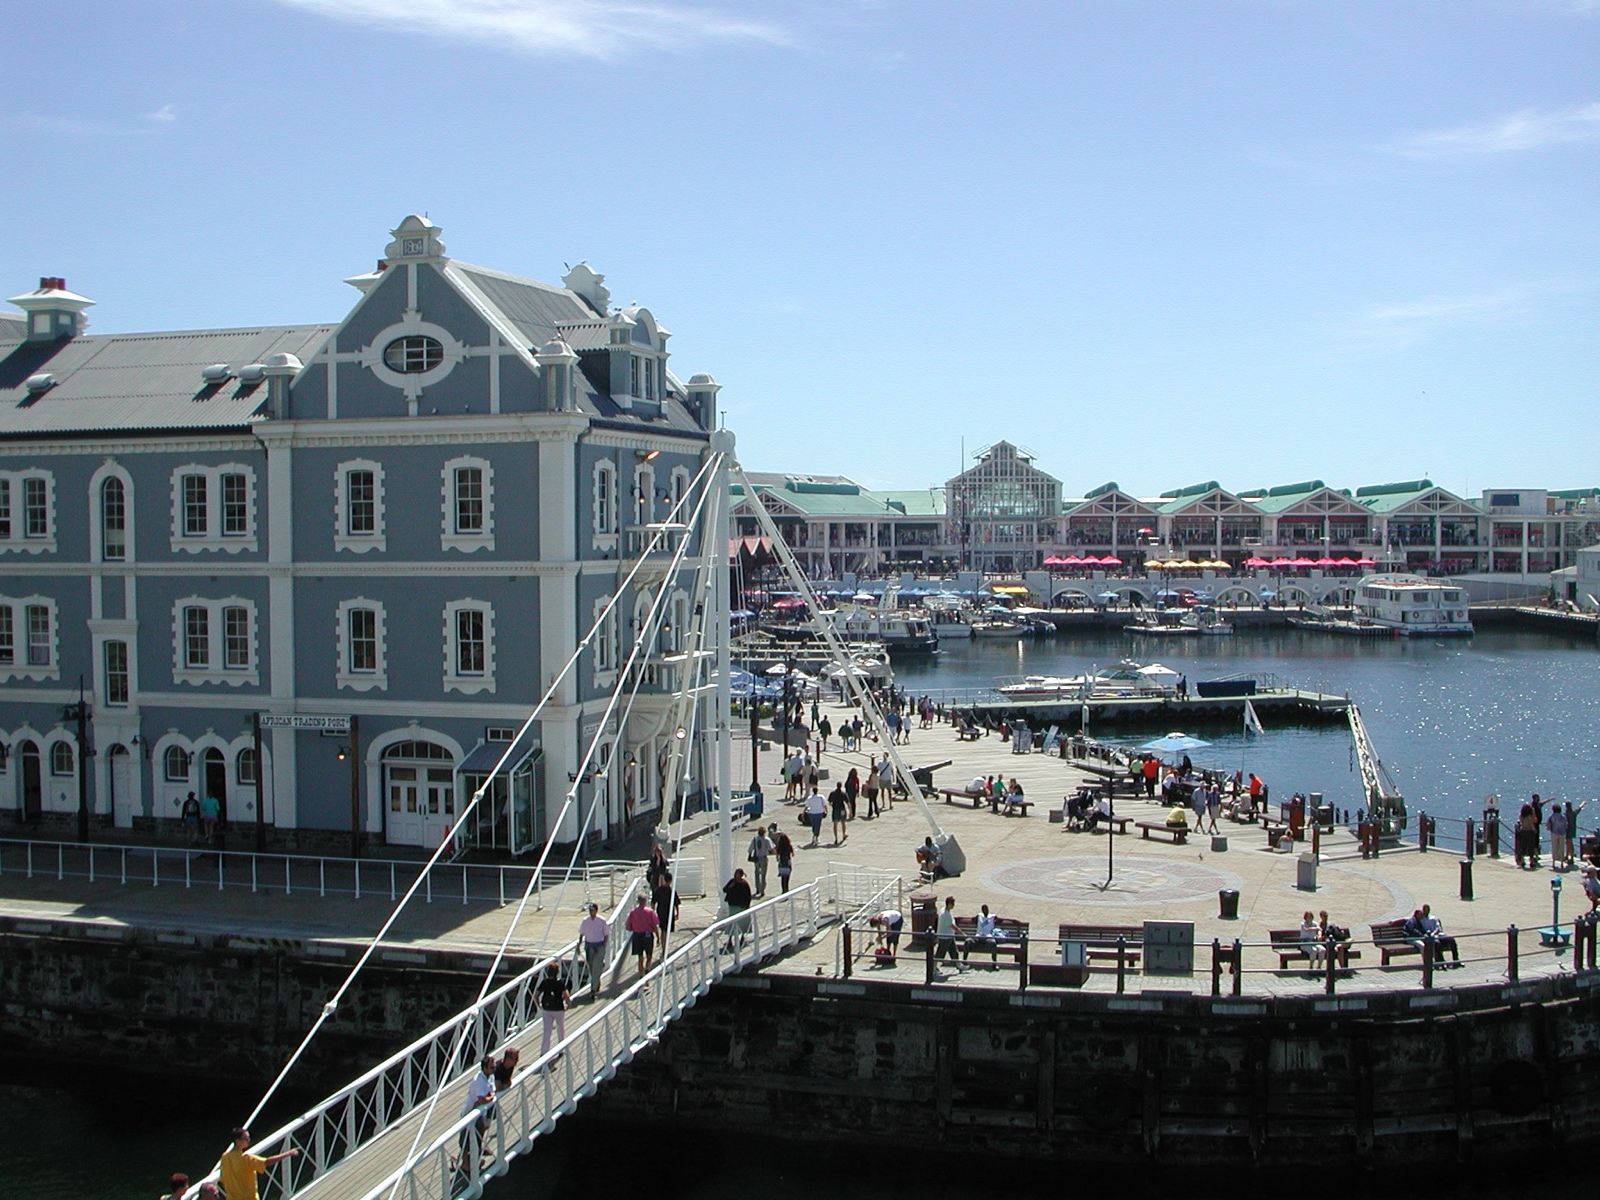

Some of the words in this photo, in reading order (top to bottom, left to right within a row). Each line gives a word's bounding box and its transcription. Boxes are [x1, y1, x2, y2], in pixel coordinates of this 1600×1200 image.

[260, 716, 292, 726] AFRICAN
[293, 717, 326, 727] TRADING
[327, 718, 346, 727] PORT
